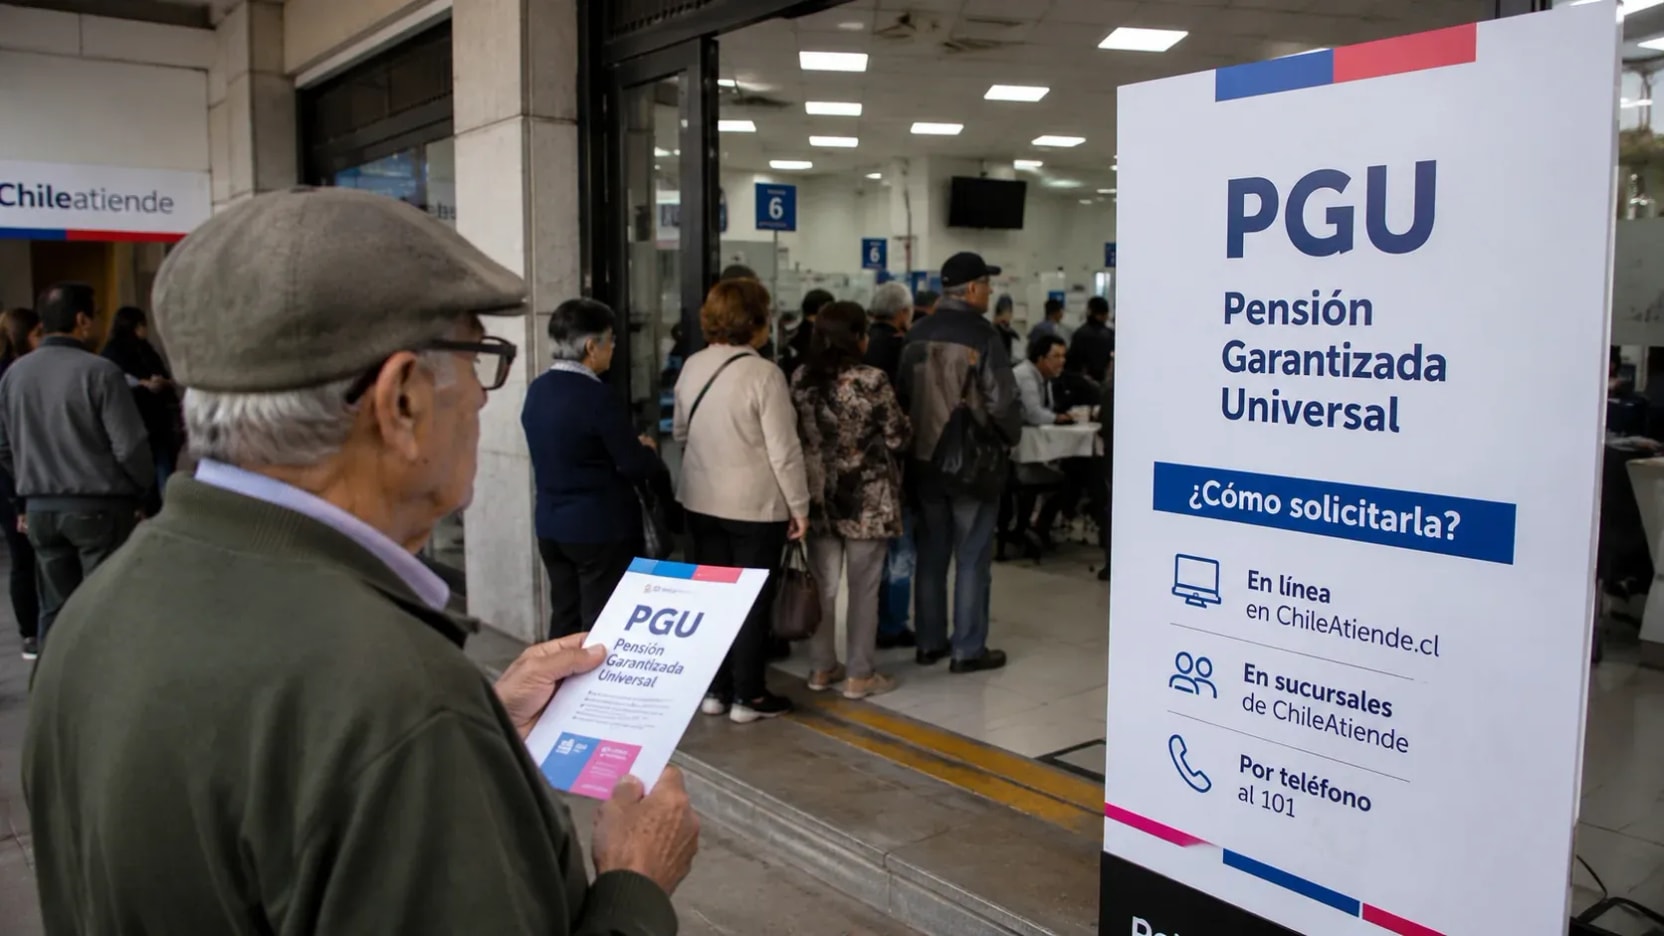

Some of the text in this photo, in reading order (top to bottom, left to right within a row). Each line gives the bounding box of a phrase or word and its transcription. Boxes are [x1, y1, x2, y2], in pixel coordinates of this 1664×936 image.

[0, 183, 175, 213] Chileatiende
[769, 197, 784, 220] 6
[1226, 160, 1437, 259] PGU
[870, 247, 881, 263] 6
[1224, 289, 1373, 326] Pensión
[1221, 339, 1447, 382] Garantizada
[1221, 387, 1400, 434] Universal
[1188, 479, 1461, 541] ¿Cómo solicitarla?
[1247, 569, 1331, 604] En línea
[624, 604, 705, 639] PGU
[1246, 603, 1440, 658] en ChileAtiende.cl
[605, 653, 685, 676] Garantizada
[613, 637, 665, 657] Pensión
[597, 668, 659, 689] Universal
[1243, 662, 1393, 718] En sucursales
[1242, 692, 1409, 754] de ChileAtiende
[1238, 784, 1295, 818] al 101
[1239, 754, 1372, 812] Por teléfono
